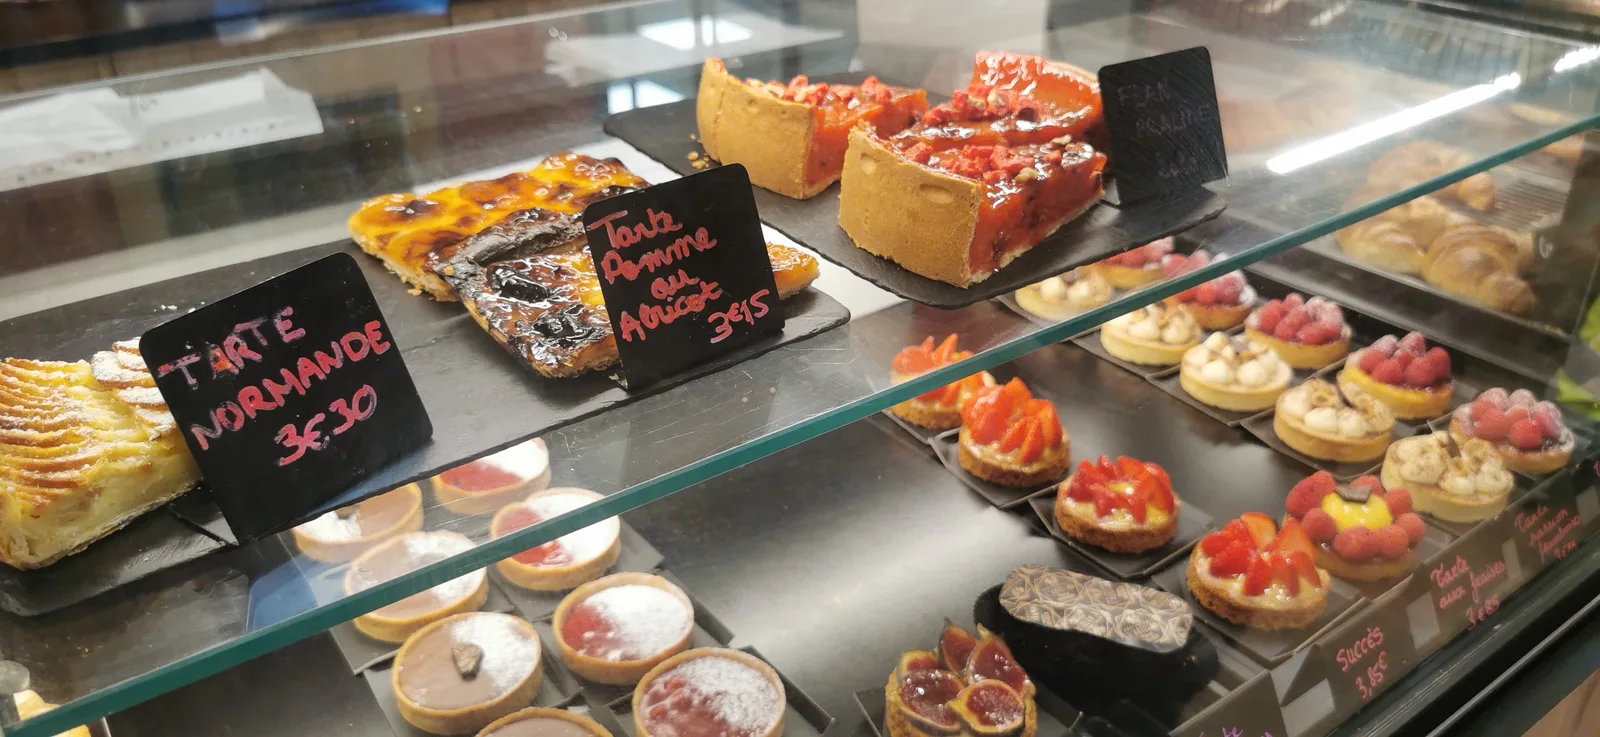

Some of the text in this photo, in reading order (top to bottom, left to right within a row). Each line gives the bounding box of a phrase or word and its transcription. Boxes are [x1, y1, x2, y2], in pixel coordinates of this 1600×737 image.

[586, 208, 683, 249] Tarte
[601, 226, 718, 284] Pomme
[619, 281, 724, 342] Abricot
[708, 289, 770, 344] 3€15
[157, 306, 305, 390] TARTE
[188, 319, 391, 451] NORMANDE
[1336, 626, 1384, 672] Succès
